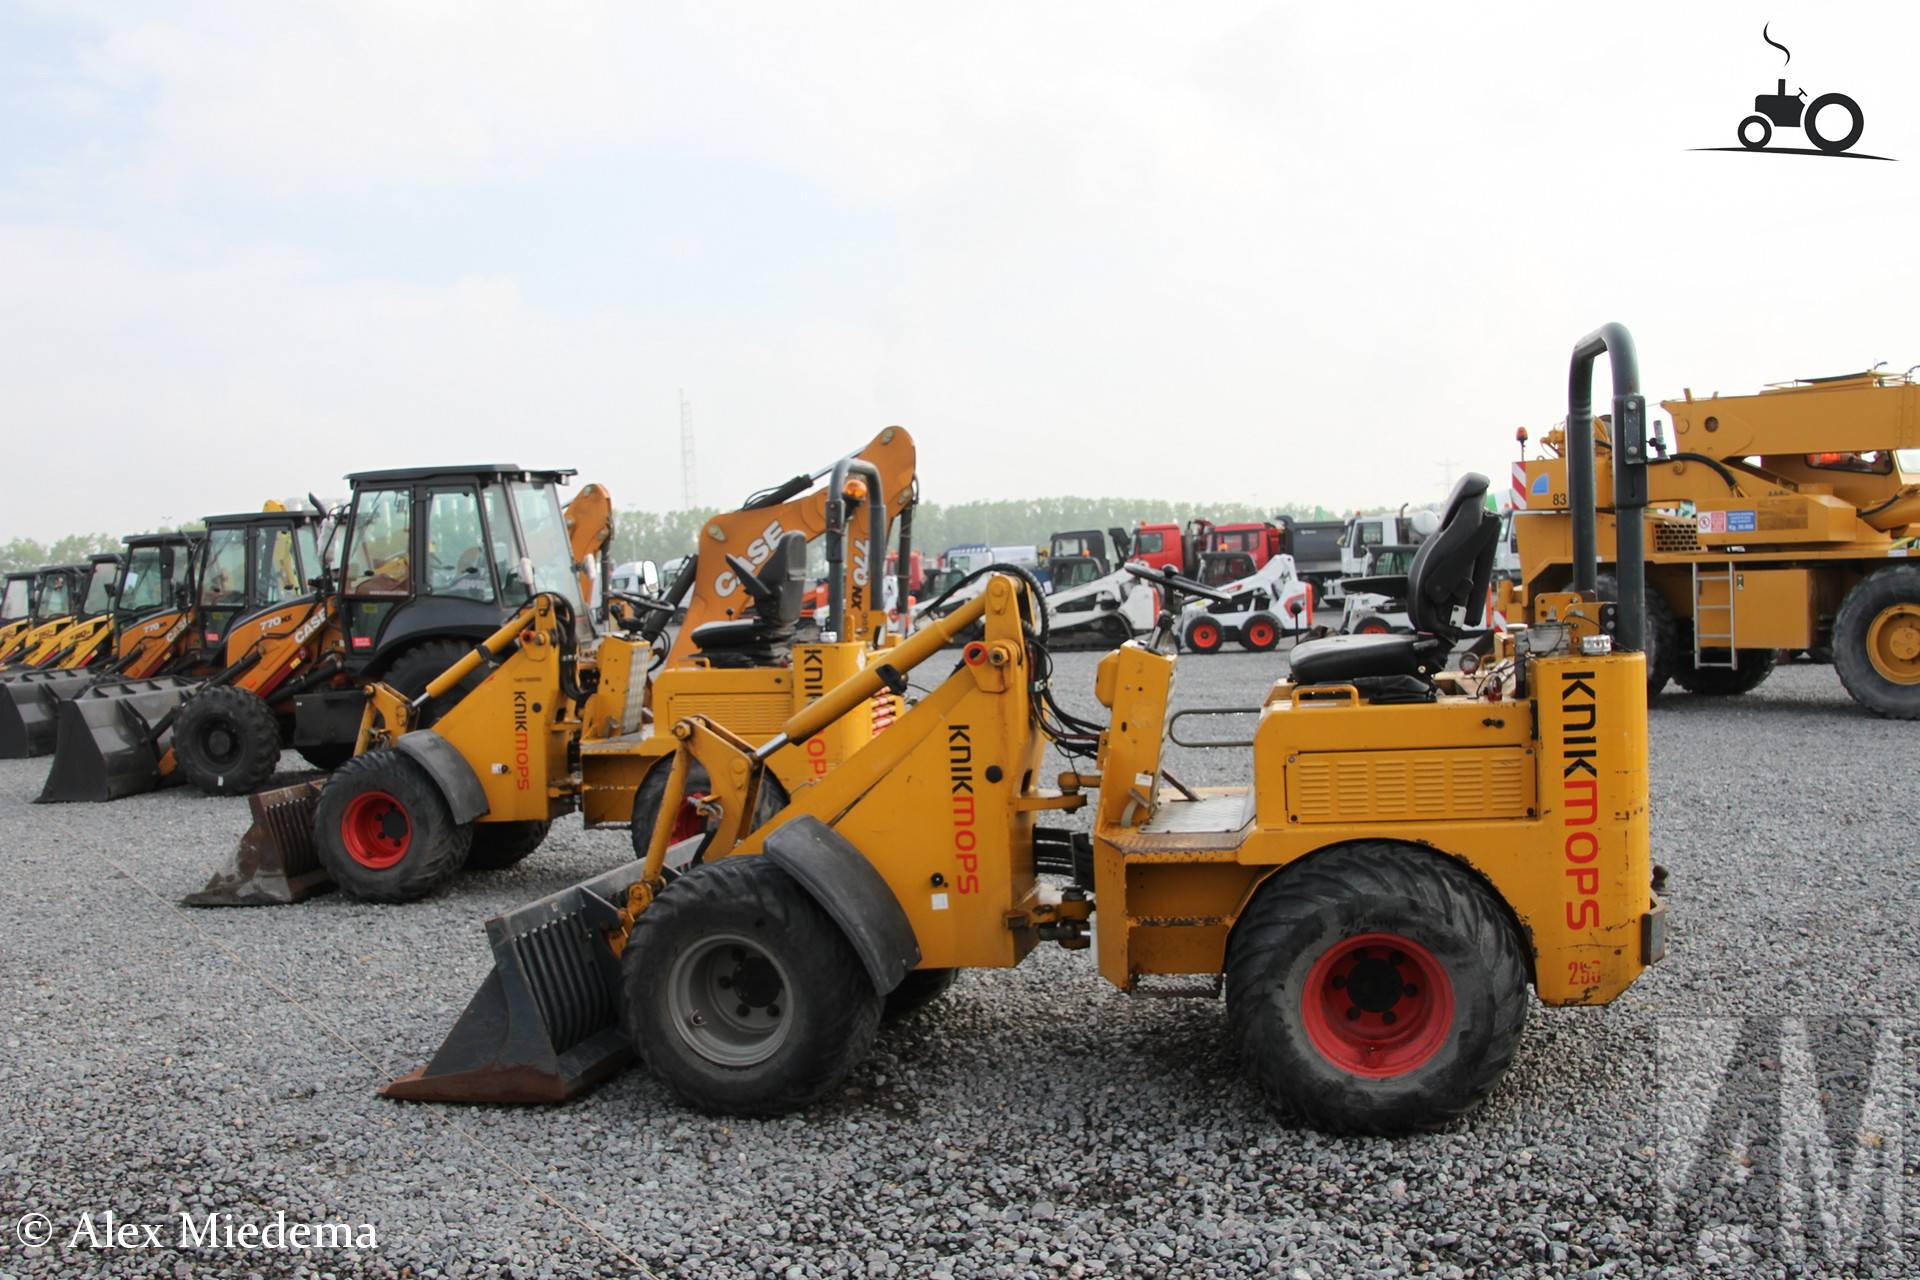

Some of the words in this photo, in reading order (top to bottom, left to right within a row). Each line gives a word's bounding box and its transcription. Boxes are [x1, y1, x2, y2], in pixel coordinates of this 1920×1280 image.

[853, 540, 870, 587] 770
[851, 586, 863, 610] NX
[260, 616, 282, 631] 770
[294, 607, 327, 643] CASE
